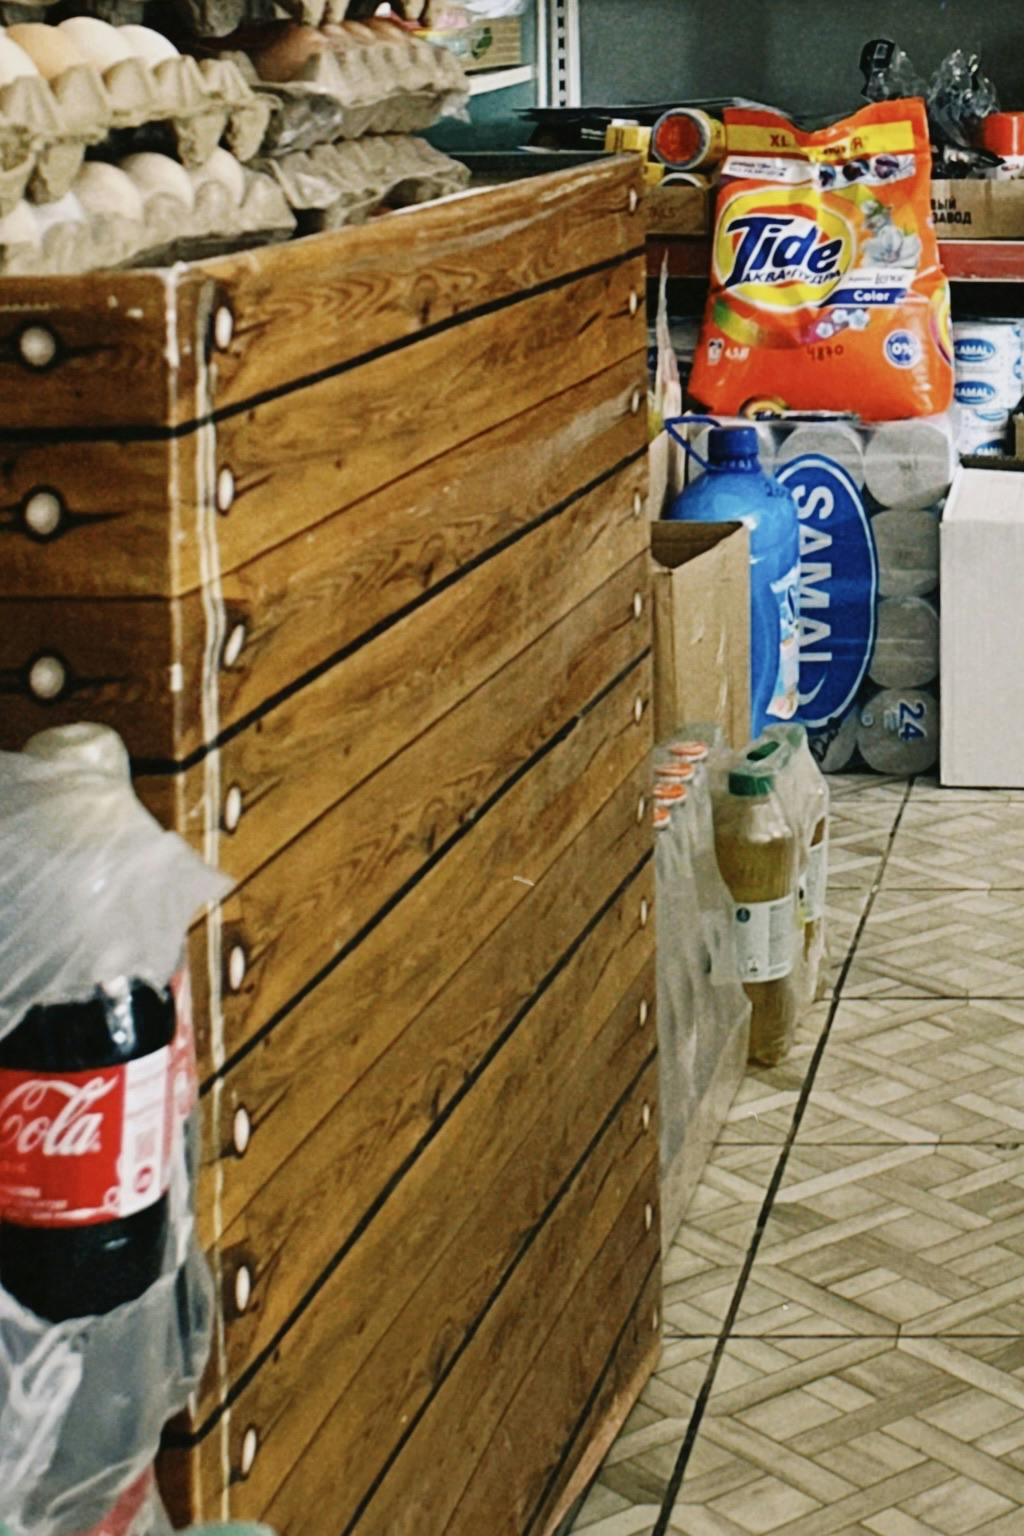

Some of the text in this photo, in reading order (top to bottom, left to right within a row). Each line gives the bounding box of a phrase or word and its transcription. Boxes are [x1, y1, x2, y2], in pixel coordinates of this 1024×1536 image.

[769, 134, 790, 147] XL
[933, 211, 972, 226] ЗАВОД
[726, 216, 843, 289] Tide
[853, 289, 891, 303] Color
[898, 703, 926, 741] 24
[0, 1076, 119, 1157] Cola
